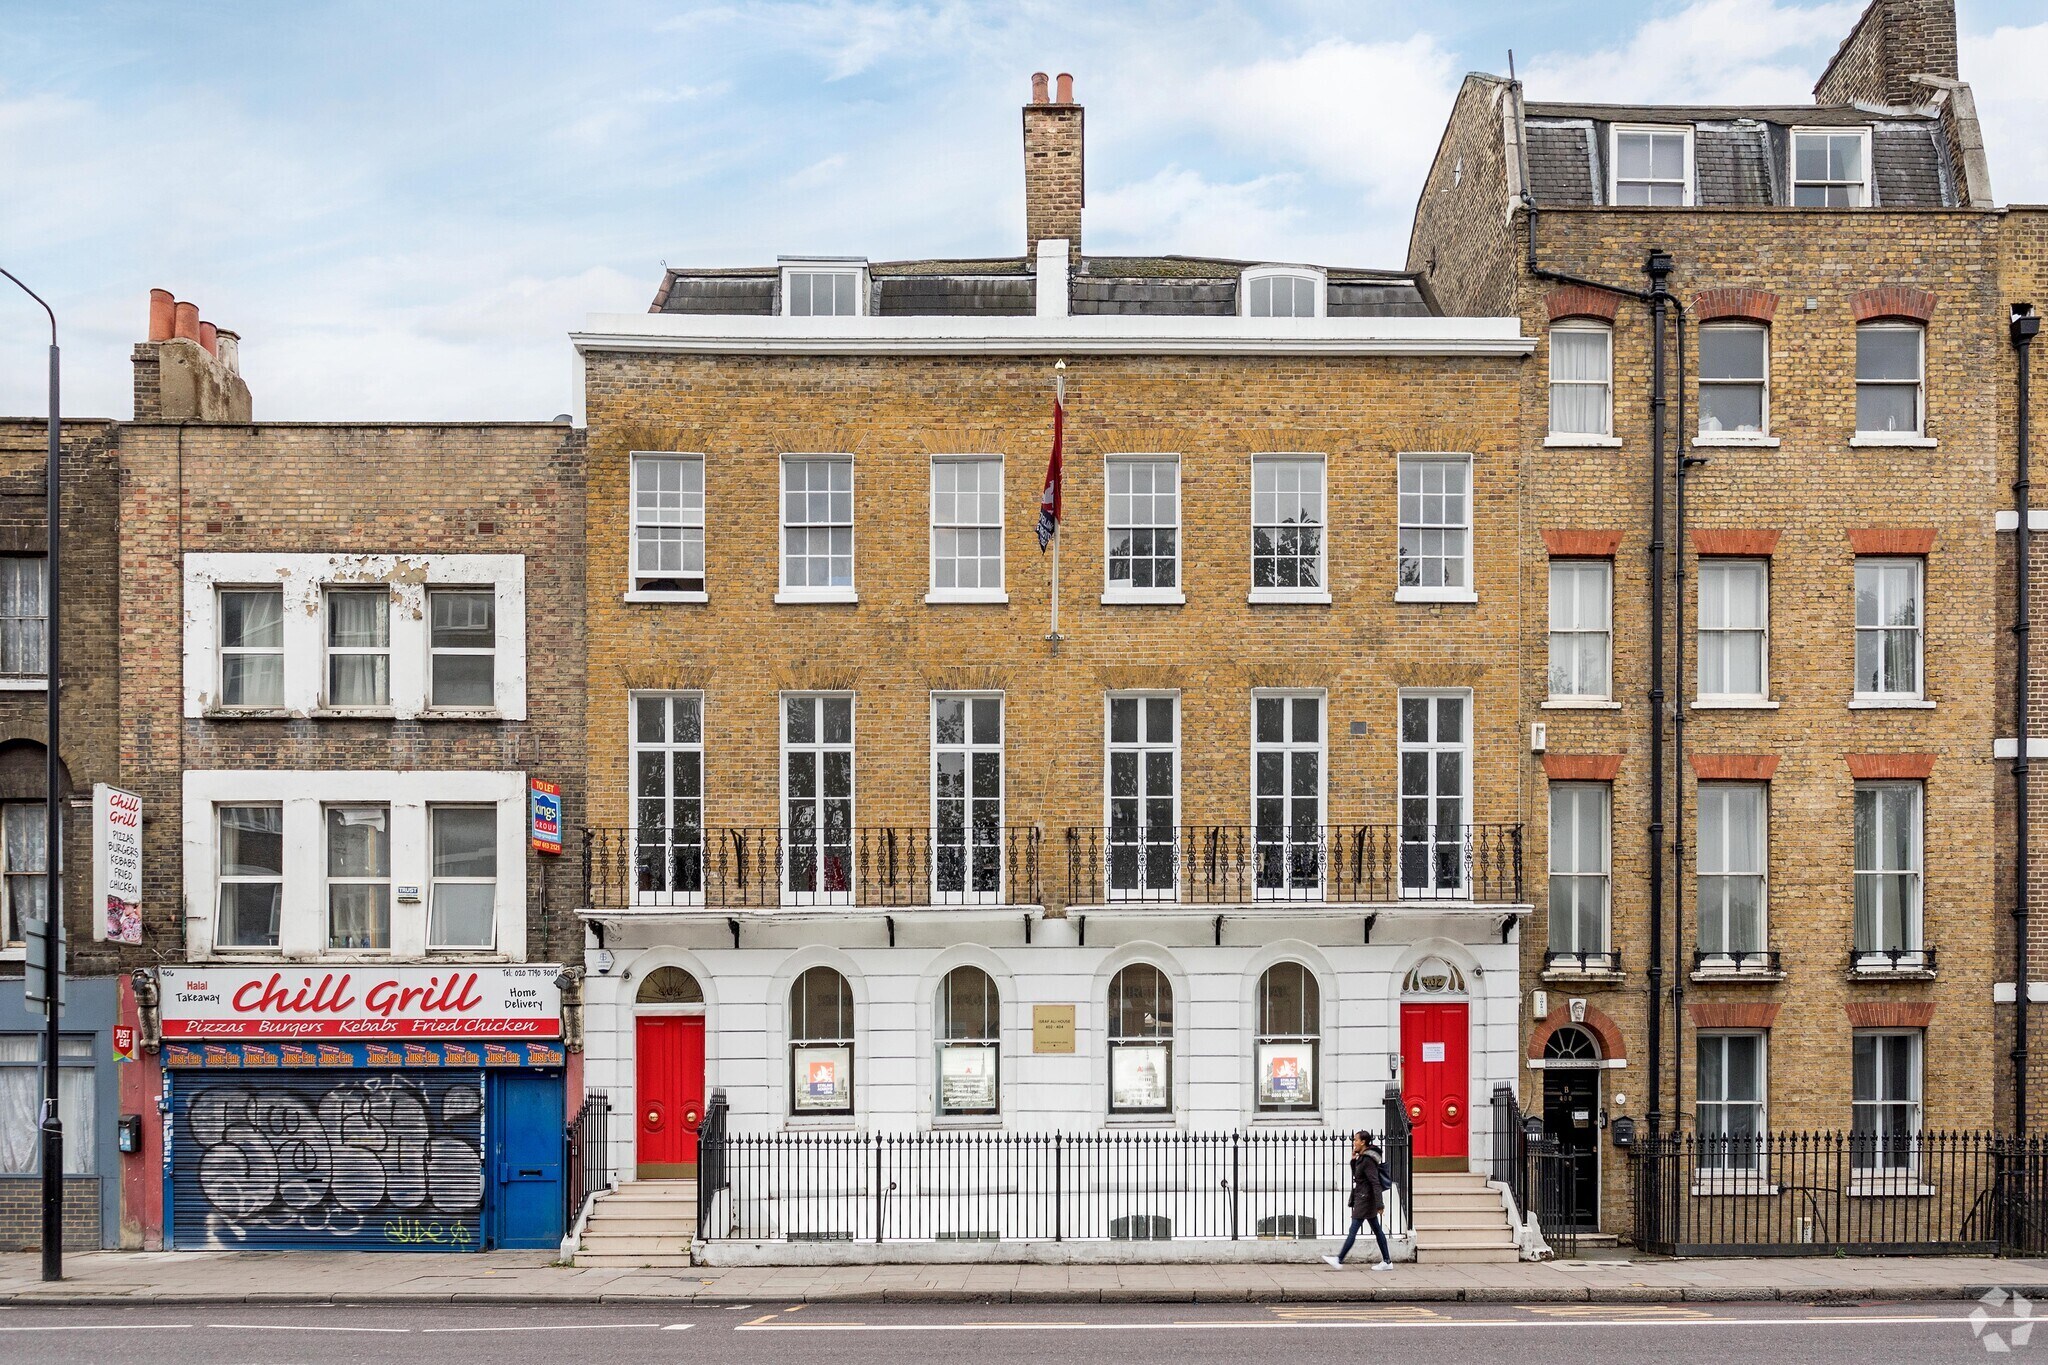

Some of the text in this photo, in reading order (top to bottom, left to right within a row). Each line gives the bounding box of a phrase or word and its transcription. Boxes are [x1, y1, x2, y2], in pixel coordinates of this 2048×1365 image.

[535, 780, 554, 793] TO LET
[110, 794, 140, 812] Chill
[535, 800, 556, 821] kings
[110, 811, 138, 828] Grill
[535, 820, 556, 832] GROUP
[112, 830, 135, 845] PIZZAS
[108, 841, 139, 859] BURGERS
[110, 854, 137, 870] KEBABS
[114, 868, 133, 881] FRIED
[109, 879, 138, 894] CHICKEN
[502, 969, 513, 977] Tel:
[187, 981, 208, 990] Halal
[510, 987, 537, 997] Home
[176, 992, 221, 1004] Takeaway
[232, 972, 483, 1016] Chill Grill
[504, 999, 543, 1010] Delivery
[116, 1029, 131, 1039] JUST
[185, 1018, 539, 1037] Pizzas Burgers Kebabs Fried Chicken
[119, 1039, 130, 1048] EAT
